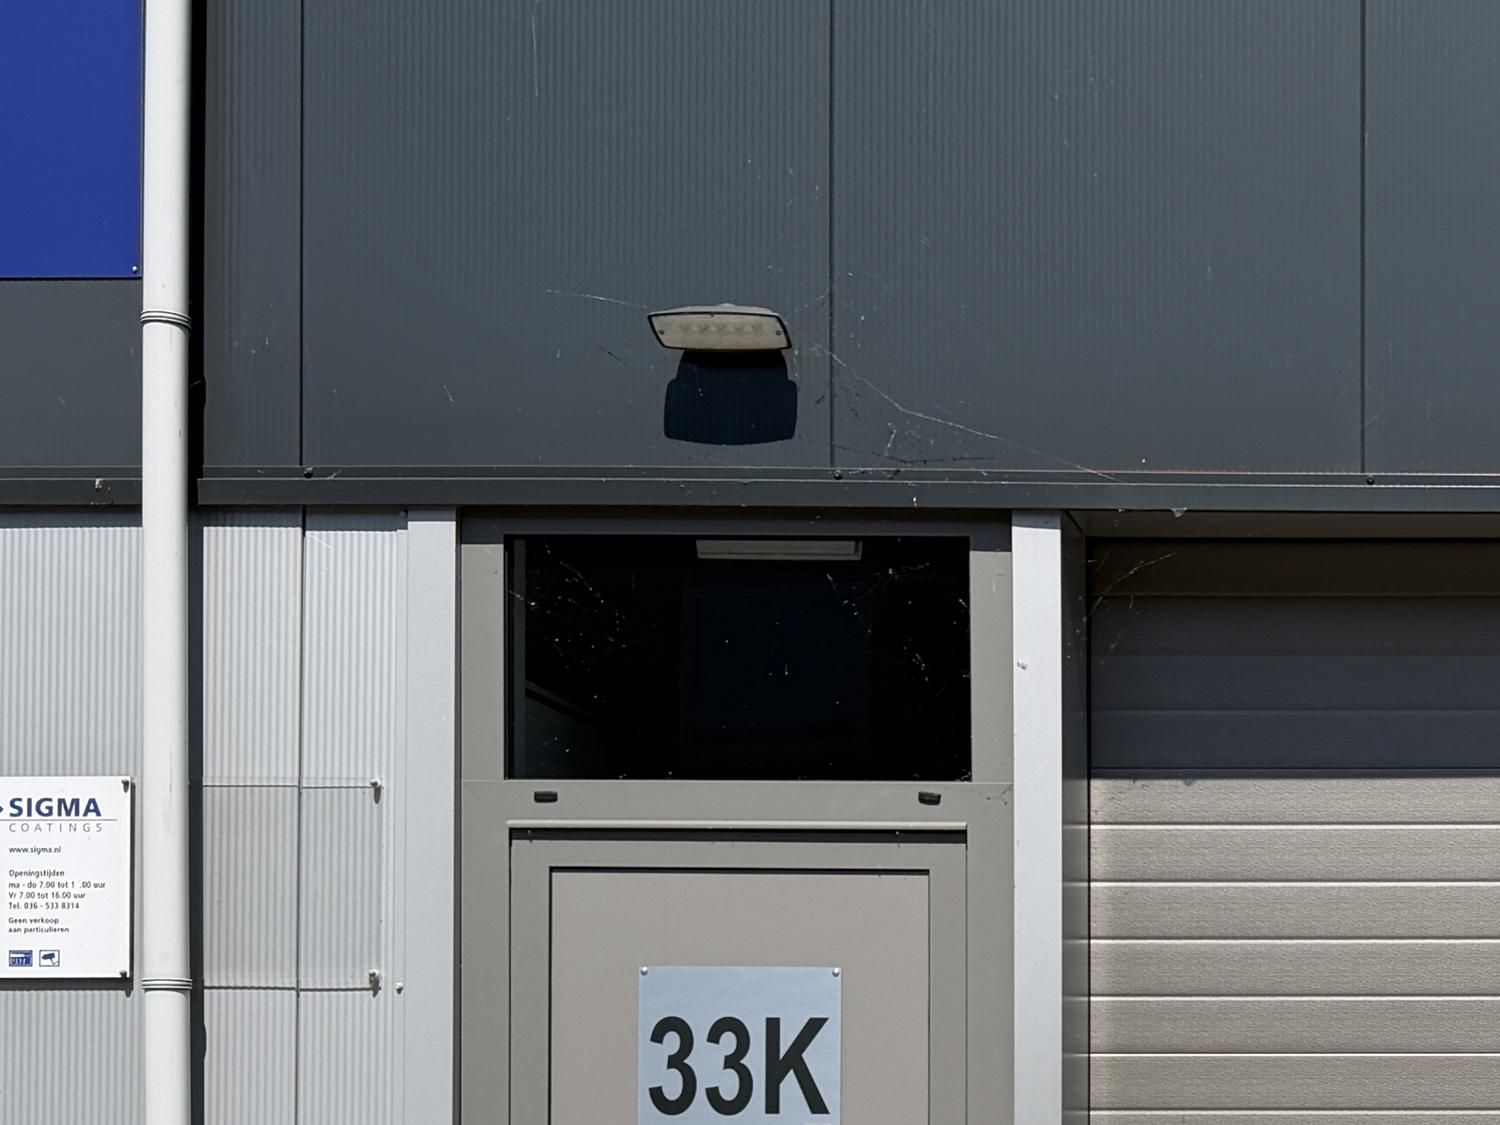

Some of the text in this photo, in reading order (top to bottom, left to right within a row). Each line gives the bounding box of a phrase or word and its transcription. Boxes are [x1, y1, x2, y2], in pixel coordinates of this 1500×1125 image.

[9, 797, 102, 818] SIGMA
[9, 823, 103, 833] COATINGS
[8, 845, 62, 855] www.sigma.nl
[8, 869, 65, 879] Openingstijden
[8, 881, 20, 889] ma
[27, 881, 37, 889] do
[39, 881, 55, 889] 7.00
[57, 881, 68, 889] tot
[8, 891, 17, 899] Vr
[19, 891, 35, 899] 7.00
[37, 891, 49, 899] tot
[51, 891, 71, 899] 16.00
[8, 902, 22, 910] Tel.
[24, 902, 38, 910] 036
[29, 917, 60, 925] verkoop
[23, 926, 70, 934] particulieren
[648, 1015, 830, 1116] 33K
